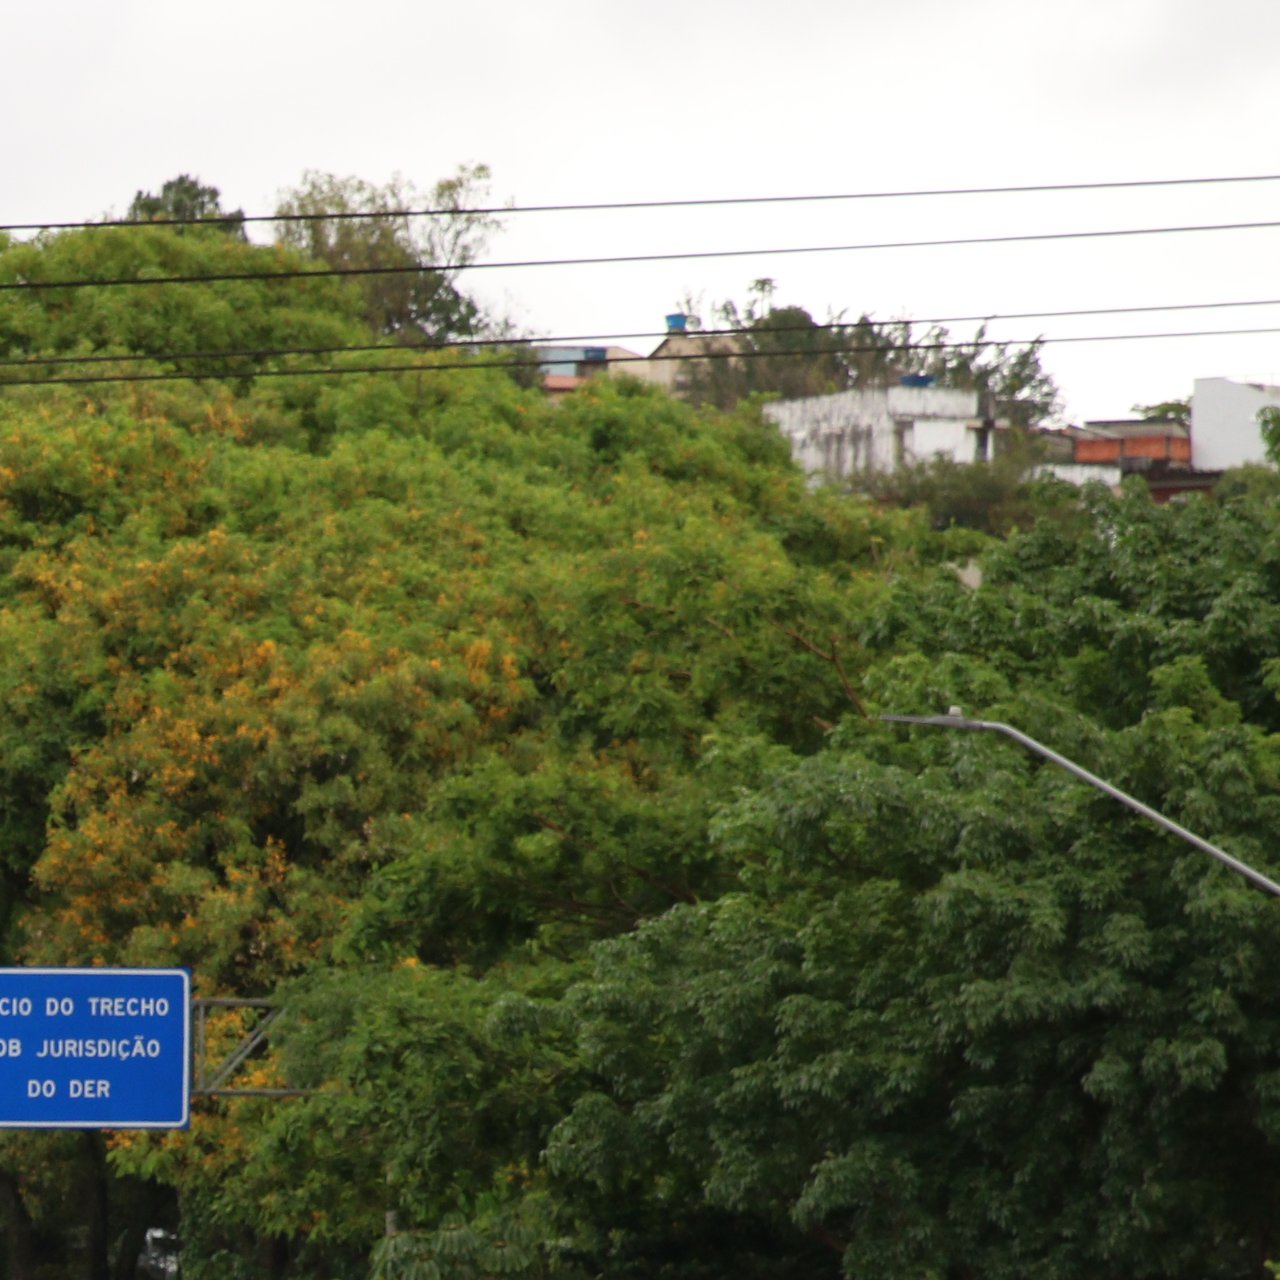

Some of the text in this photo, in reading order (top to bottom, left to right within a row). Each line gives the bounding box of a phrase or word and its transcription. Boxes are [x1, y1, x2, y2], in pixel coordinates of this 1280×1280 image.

[45, 998, 74, 1016] DO
[88, 998, 169, 1017] TRECHO
[36, 1035, 160, 1061] JURISDIÇÃO
[27, 1079, 111, 1098] DO DER
